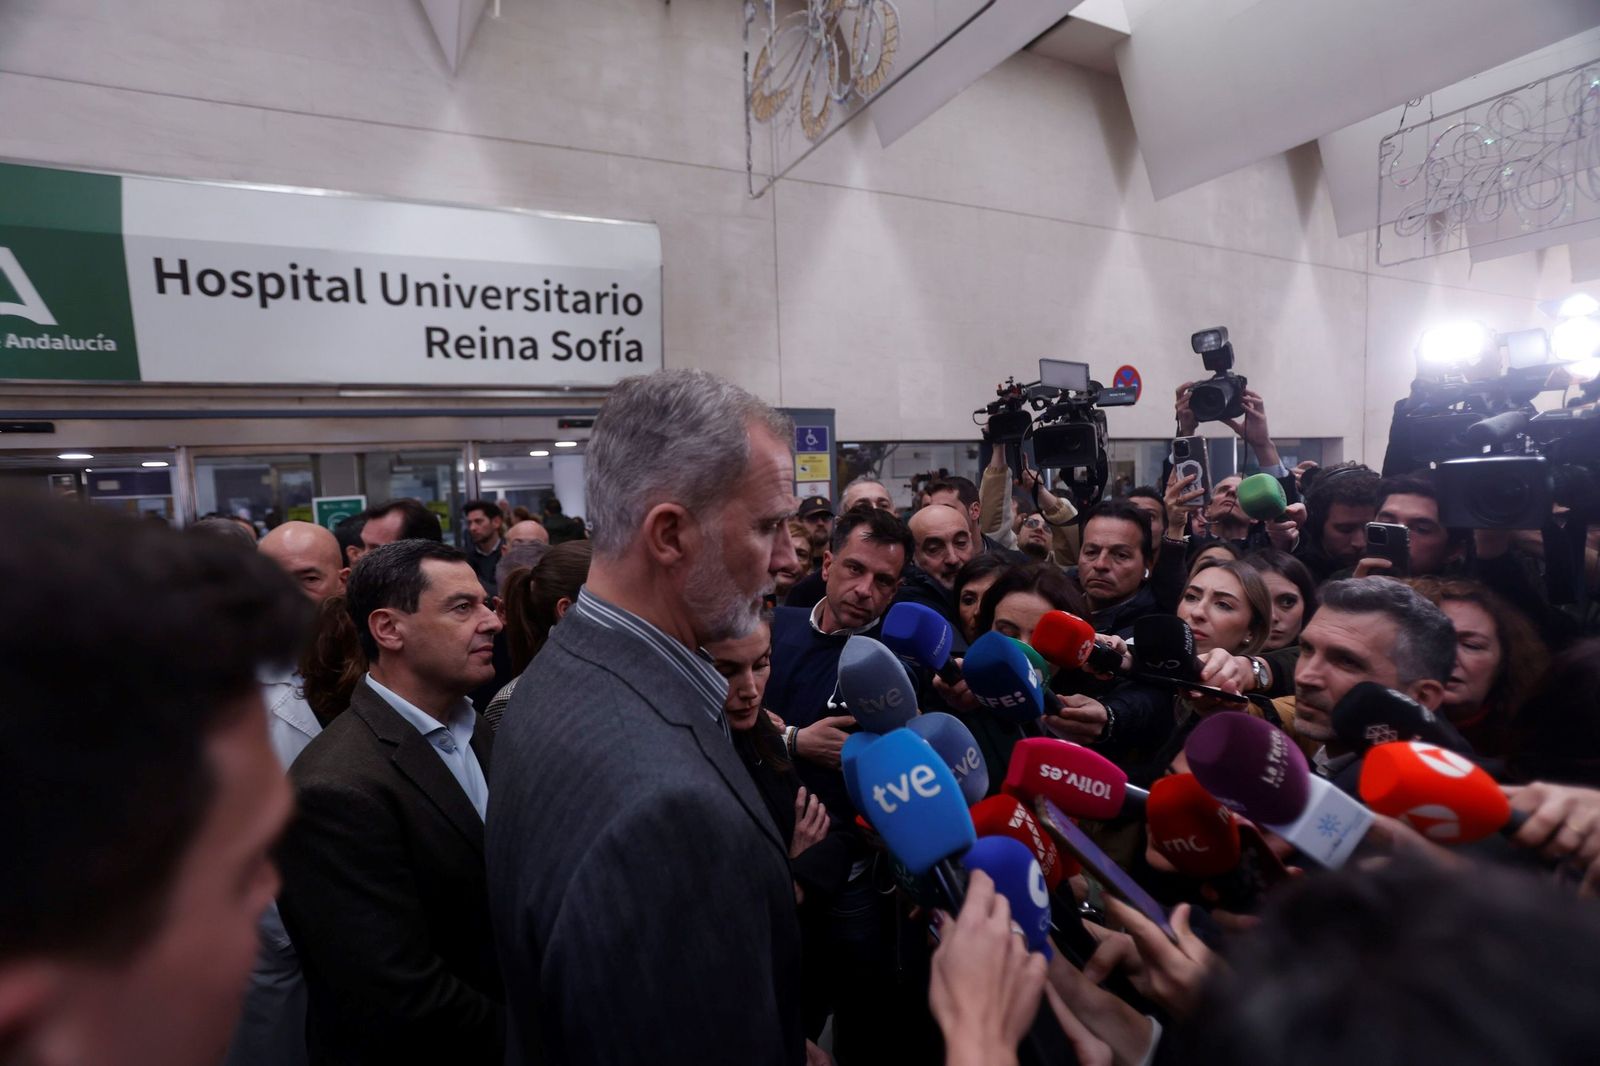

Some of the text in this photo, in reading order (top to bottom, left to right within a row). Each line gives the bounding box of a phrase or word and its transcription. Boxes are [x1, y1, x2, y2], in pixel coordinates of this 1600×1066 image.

[153, 257, 644, 317] Hospital Universitario
[5, 332, 117, 352] Andalucía
[425, 326, 644, 363] Reina Sofía
[857, 687, 904, 714] tve
[872, 763, 941, 815] tve
